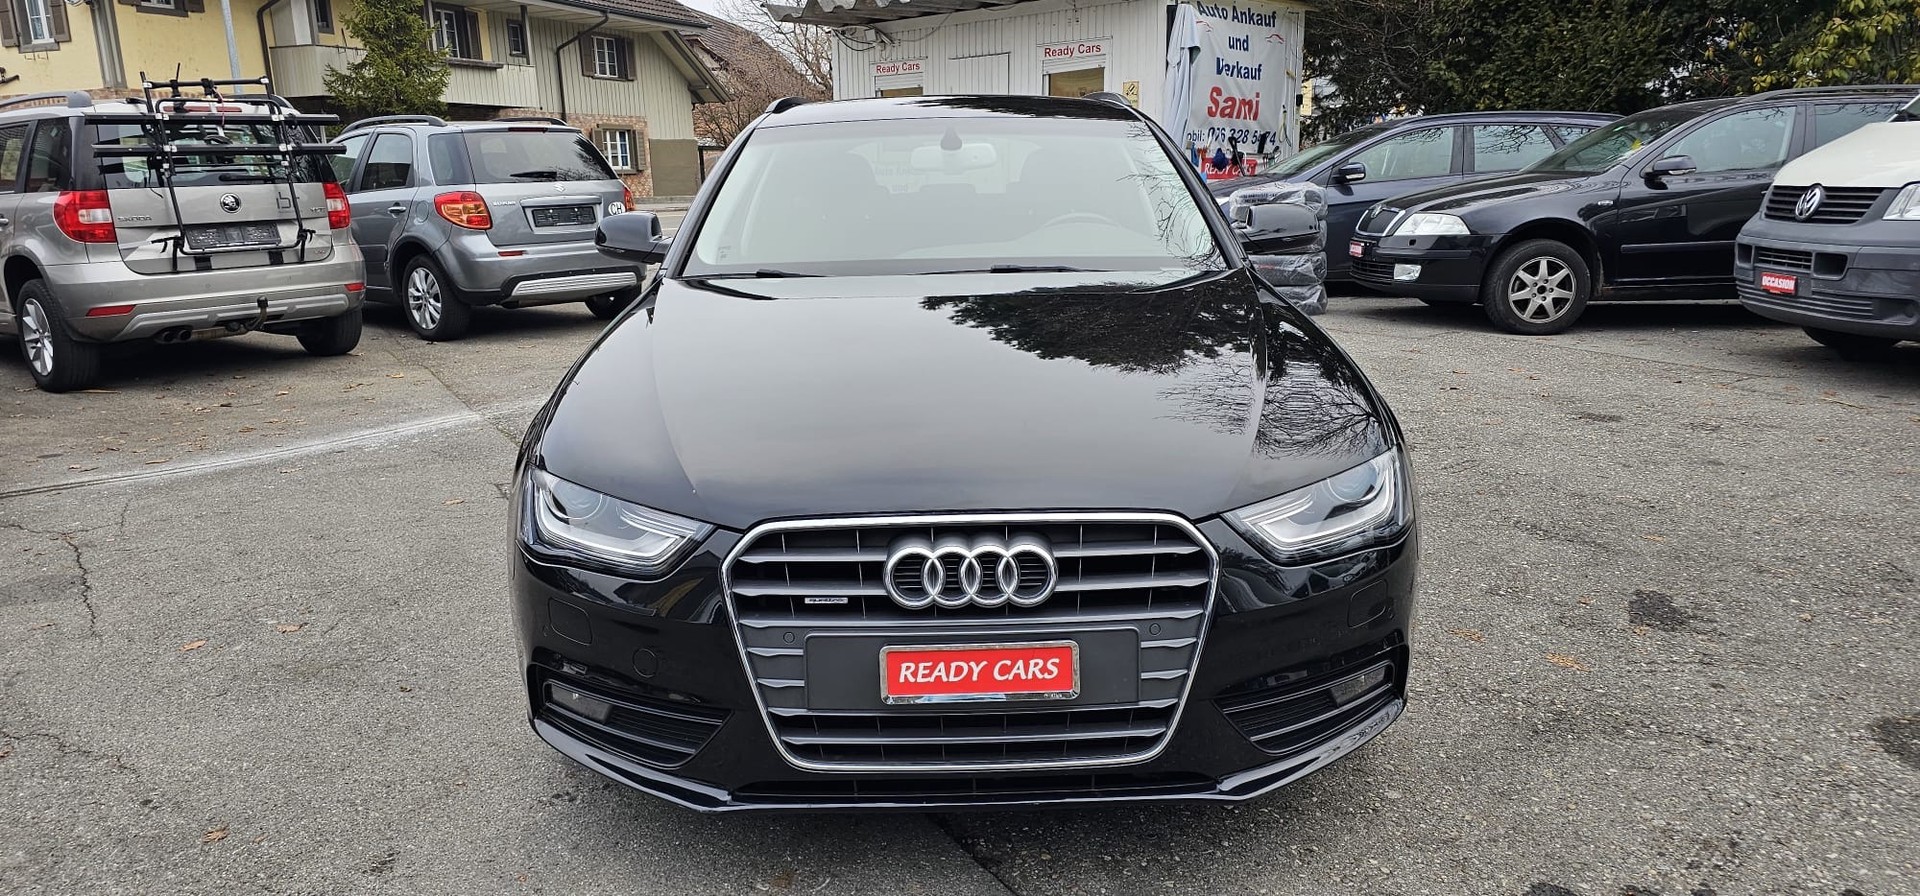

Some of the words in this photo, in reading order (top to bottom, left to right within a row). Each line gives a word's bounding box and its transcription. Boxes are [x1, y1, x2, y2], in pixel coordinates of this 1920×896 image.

[1196, 1, 1228, 20] Auto
[1231, 5, 1277, 28] Ankauf
[1044, 45, 1076, 58] Ready
[1077, 43, 1102, 54] Cars
[1228, 35, 1249, 52] und
[876, 64, 900, 75] Ready
[901, 61, 921, 72] Cars
[1216, 57, 1263, 81] Verkauf
[1207, 86, 1261, 121] Sami
[1187, 129, 1205, 142] obil:
[1207, 127, 1226, 143] 076
[1251, 130, 1276, 146] 574
[610, 203, 624, 214] CH
[1762, 275, 1795, 290] OCCASION
[899, 660, 988, 683] READY
[993, 658, 1060, 680] CARS
